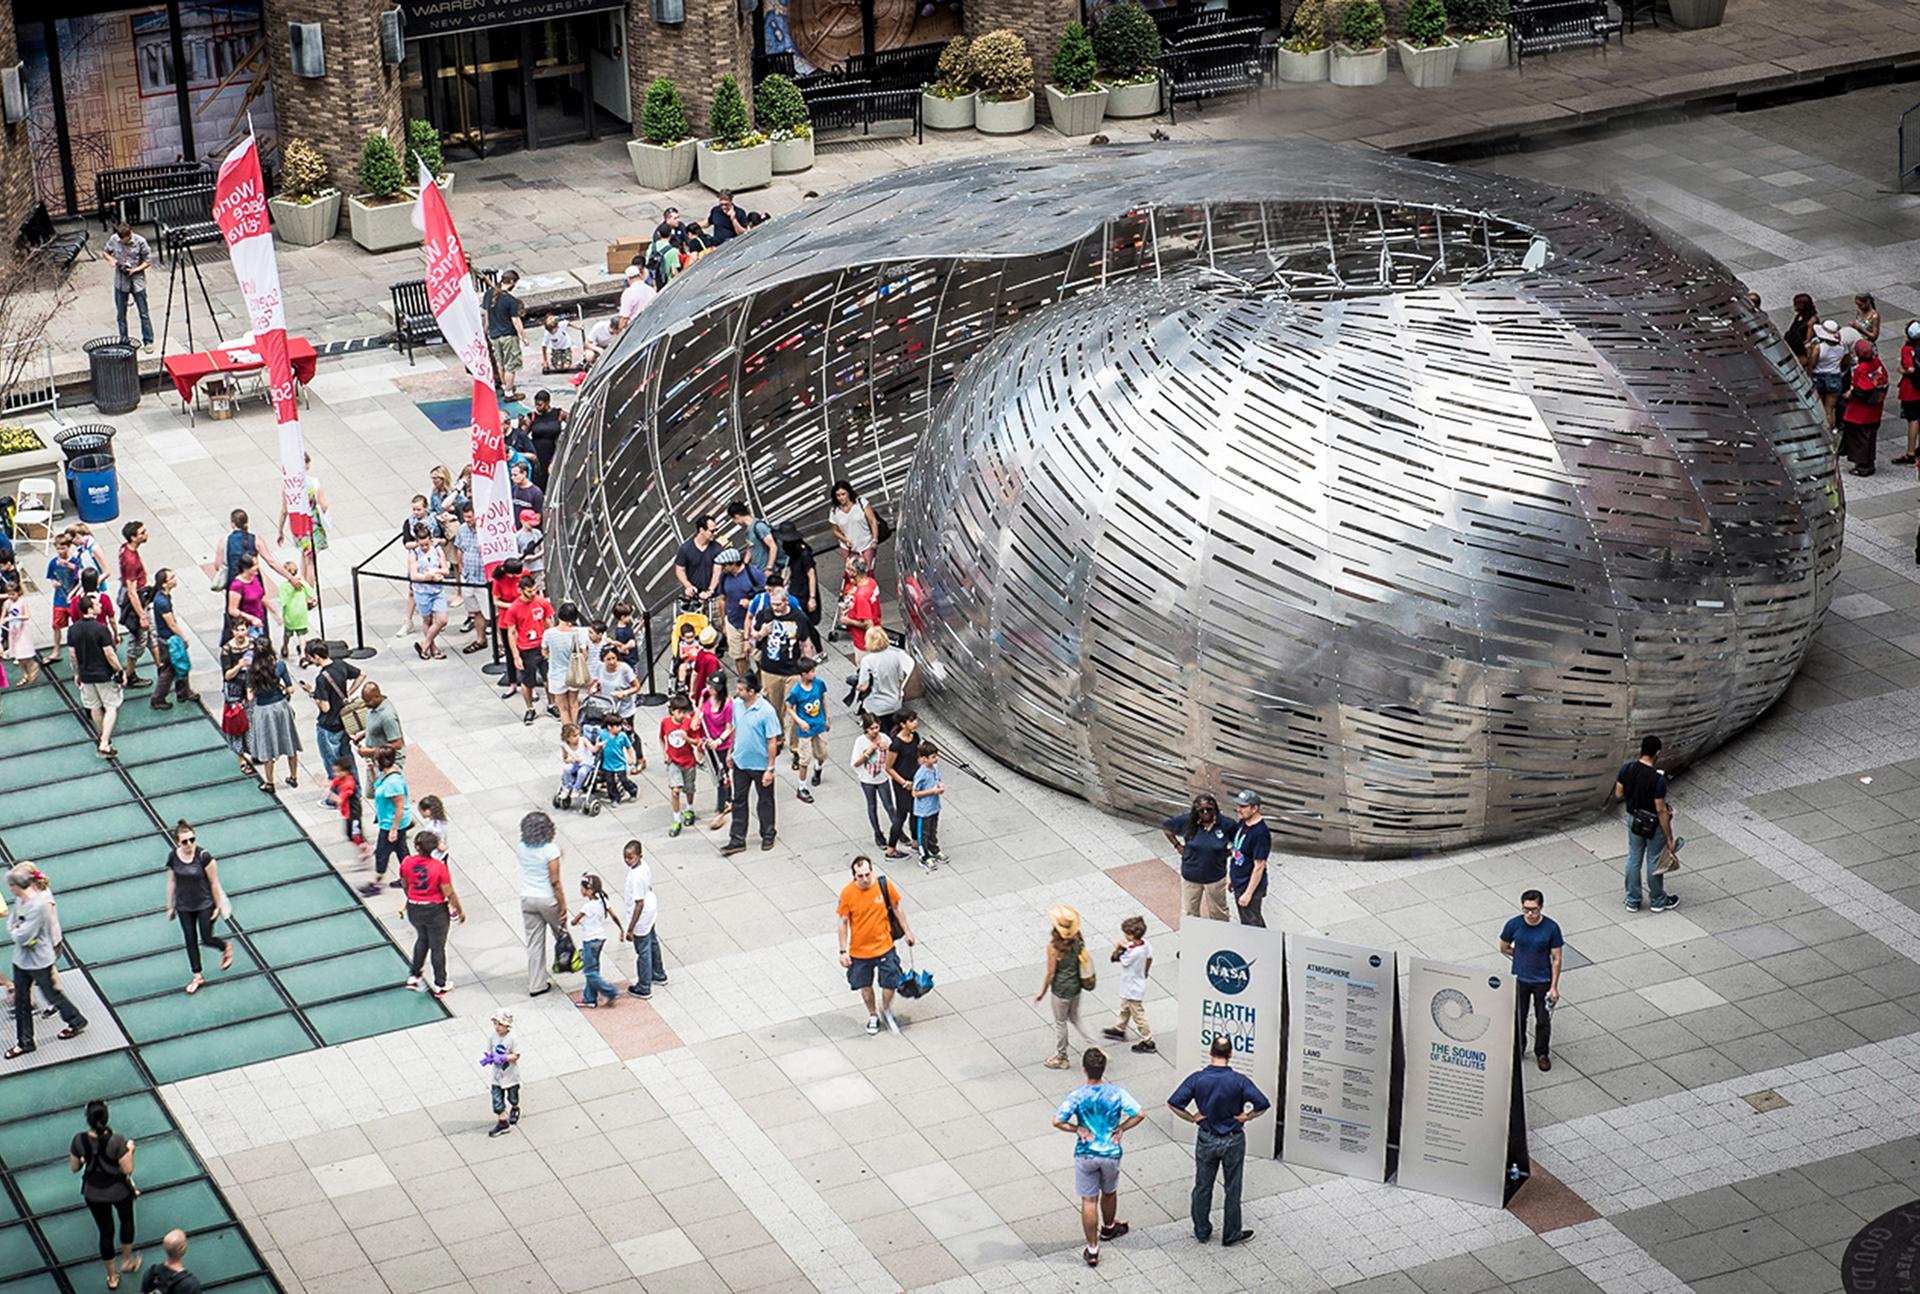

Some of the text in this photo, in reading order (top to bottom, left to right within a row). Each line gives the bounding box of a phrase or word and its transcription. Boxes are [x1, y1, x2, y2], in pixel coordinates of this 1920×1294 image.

[412, 0, 485, 17] WARREN
[430, 18, 462, 29] NEW
[469, 11, 505, 23] YORK
[512, 0, 592, 16] UNIVERSITY
[471, 418, 501, 450] orld
[413, 865, 428, 890] 3
[1209, 965, 1247, 982] NASA
[1306, 963, 1350, 979] ATMOSPHERE
[1202, 999, 1256, 1023] EARTH
[1202, 1015, 1256, 1039] FROM
[1303, 1048, 1321, 1058] LAND
[1430, 1042, 1487, 1063] THE SOUND
[1430, 1052, 1486, 1072] OF SATELLITES
[1300, 1103, 1322, 1115] OCEAN
[1851, 1227, 1893, 1290] GOULD
